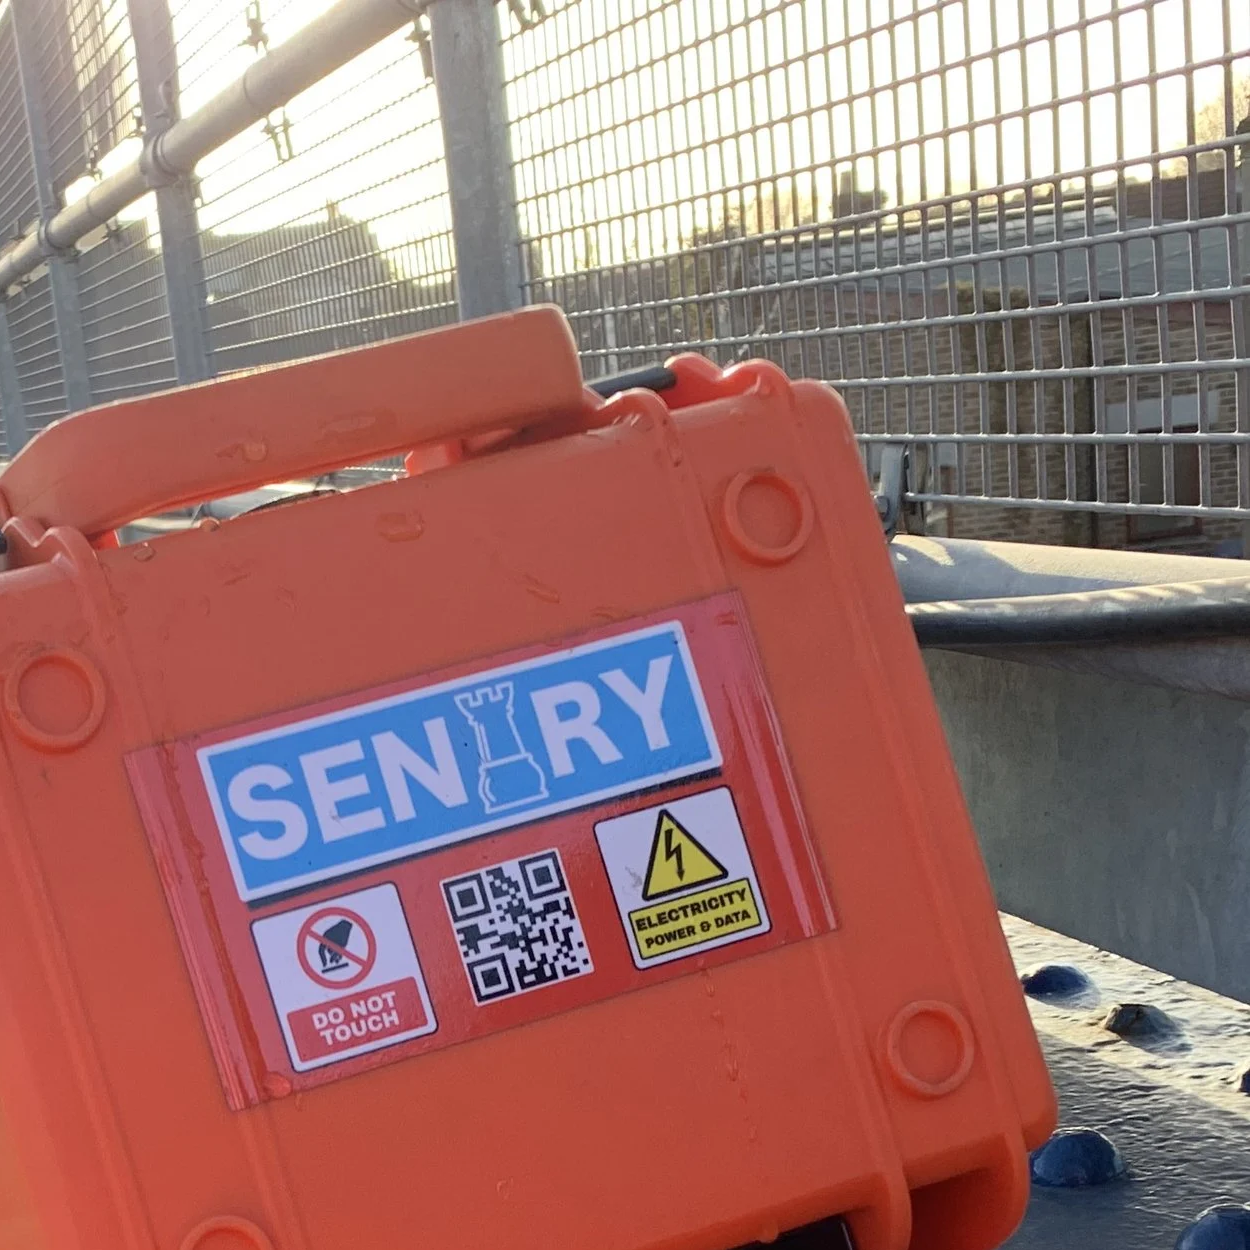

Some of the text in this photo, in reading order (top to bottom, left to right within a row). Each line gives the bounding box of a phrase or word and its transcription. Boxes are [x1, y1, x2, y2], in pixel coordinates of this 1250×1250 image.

[635, 887, 747, 932] ELECTRICITY
[645, 909, 752, 949] POWER & DATA
[311, 991, 396, 1030] DO NOT
[319, 1009, 400, 1046] TOUCH
